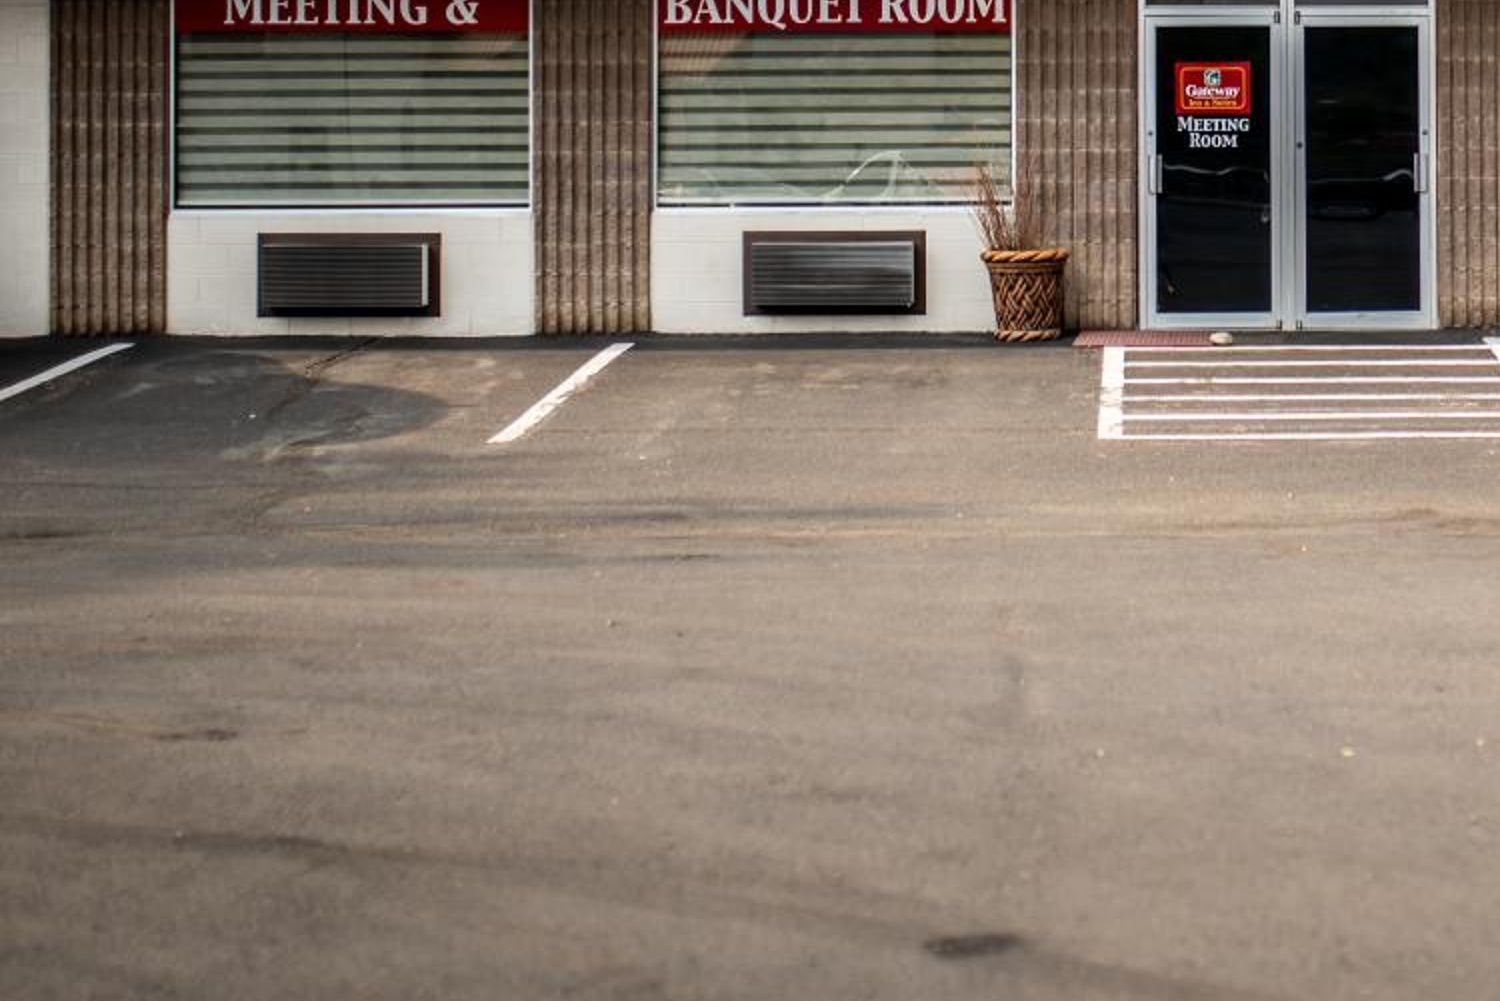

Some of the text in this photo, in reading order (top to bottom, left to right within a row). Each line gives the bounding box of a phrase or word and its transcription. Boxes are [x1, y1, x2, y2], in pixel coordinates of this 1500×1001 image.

[1185, 84, 1241, 99] Gateway
[1177, 115, 1250, 132] MEETING
[1189, 132, 1239, 148] ROOM
